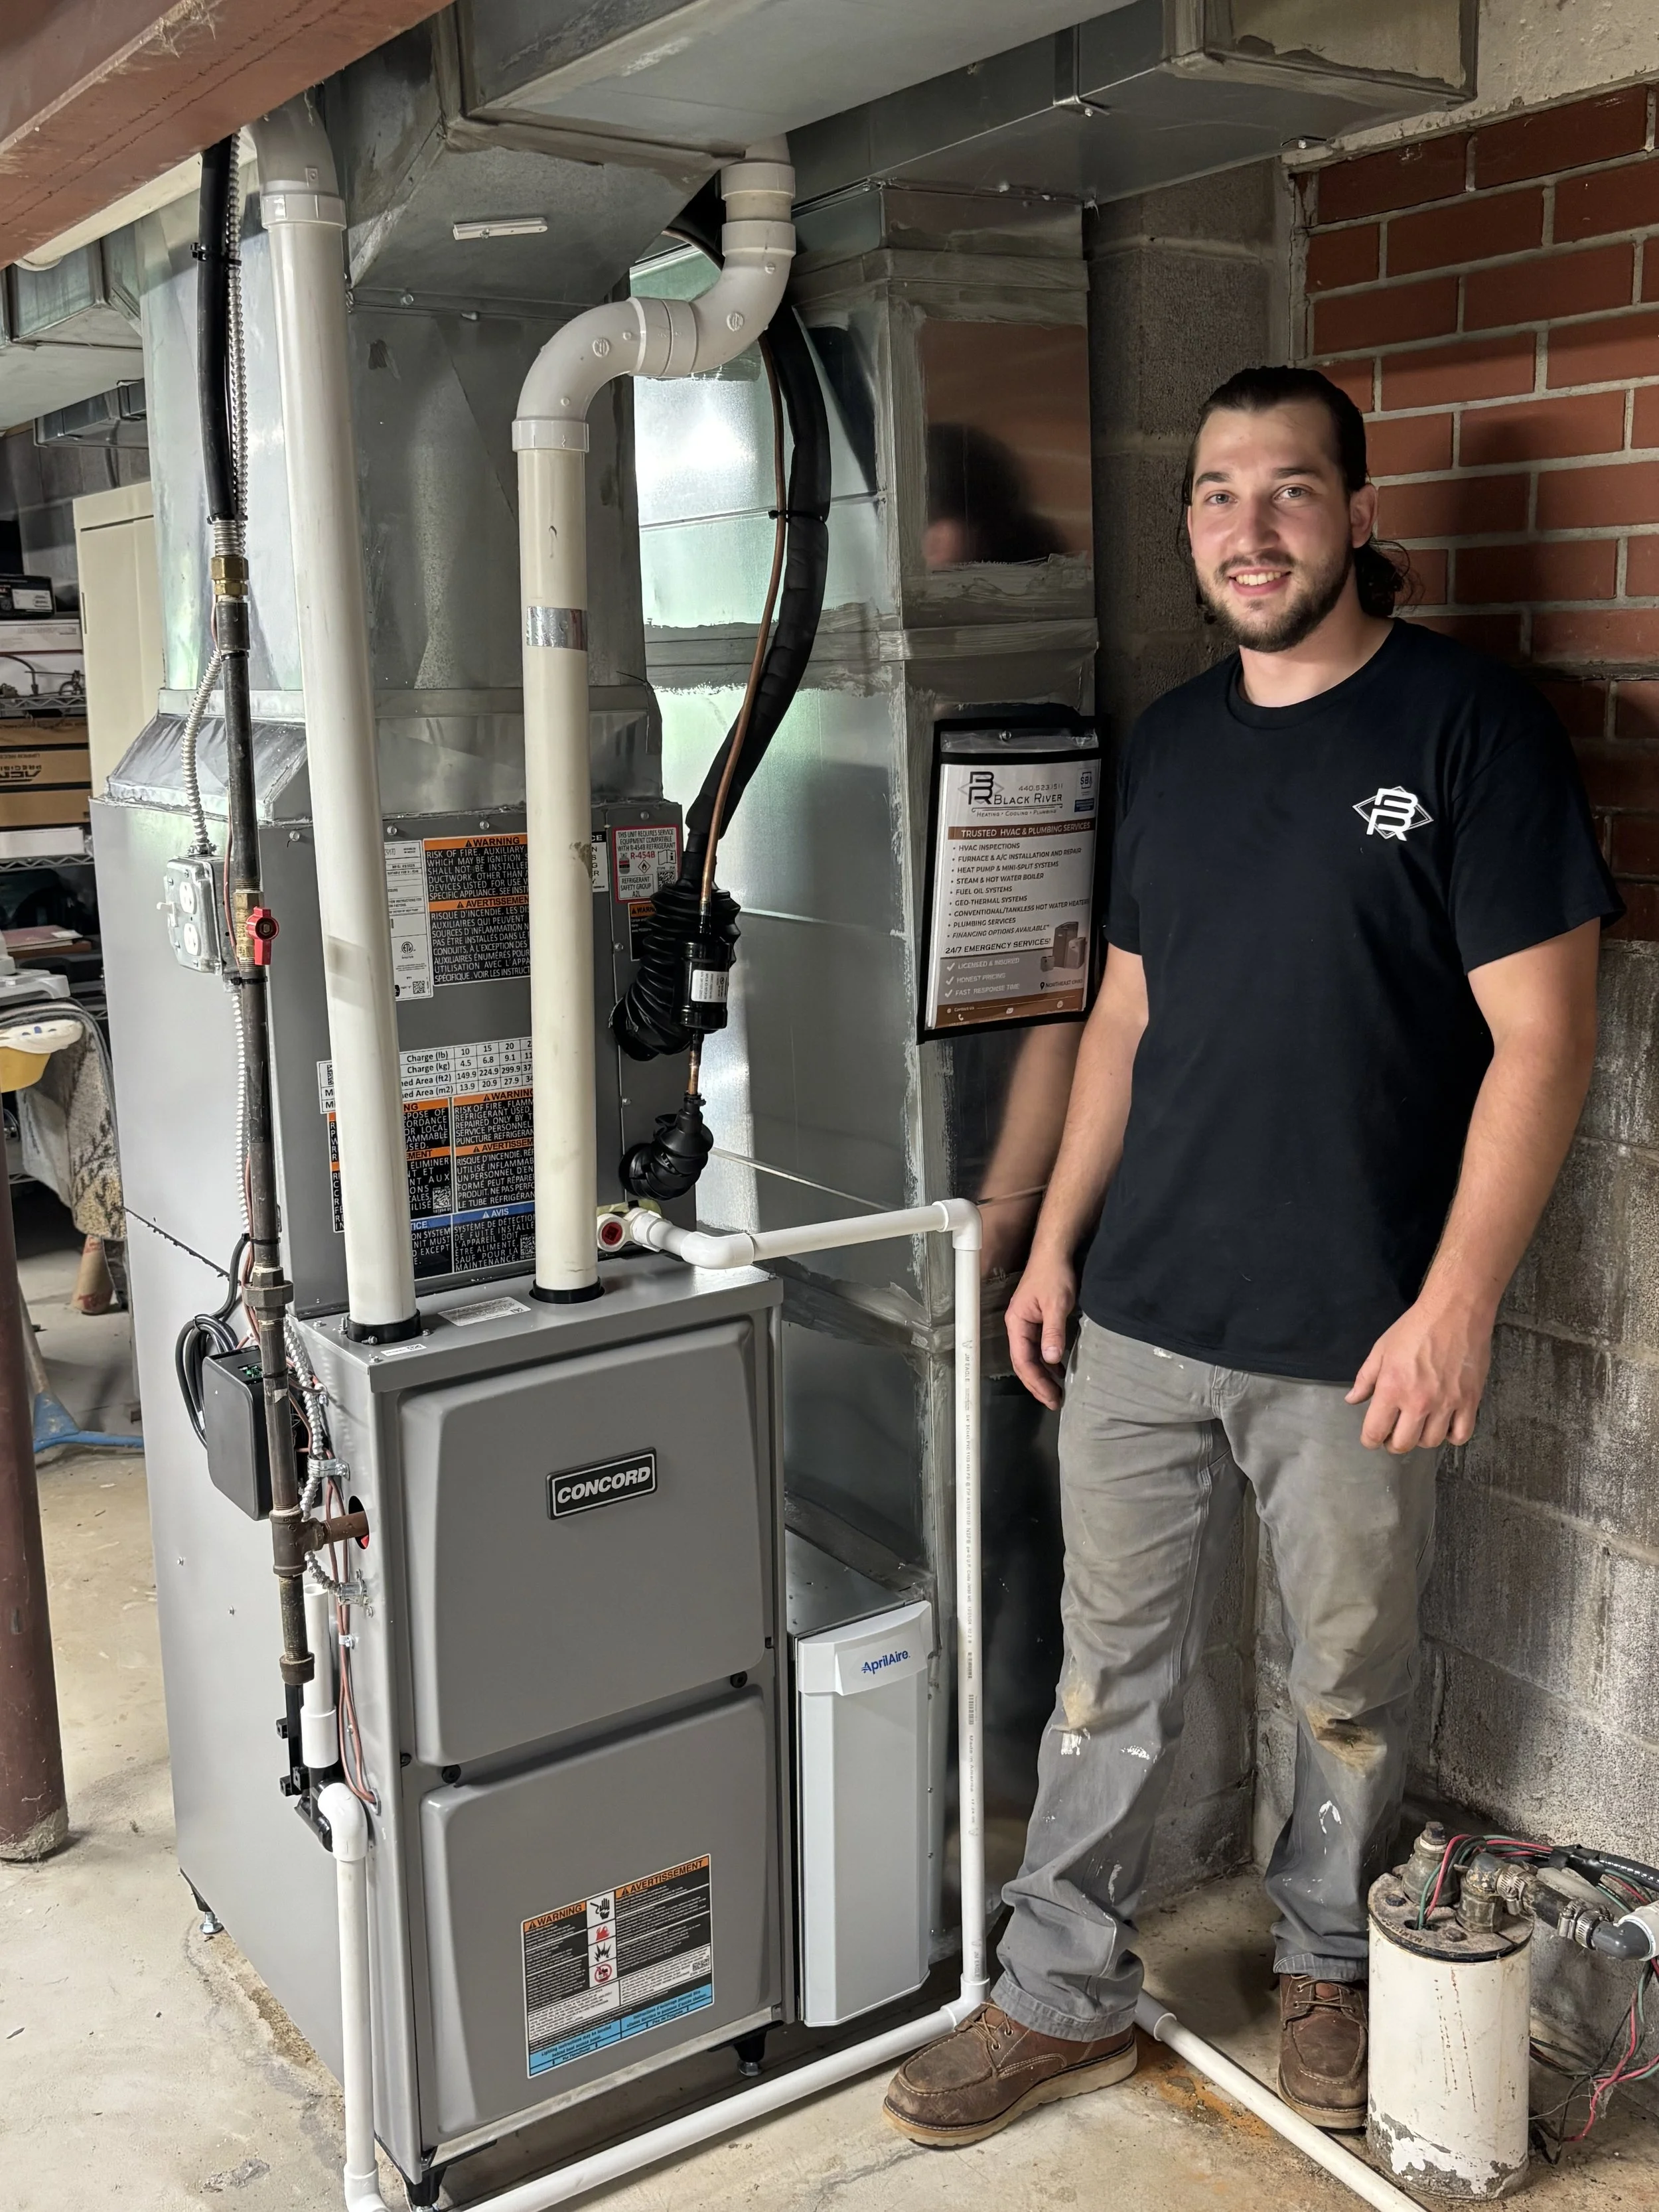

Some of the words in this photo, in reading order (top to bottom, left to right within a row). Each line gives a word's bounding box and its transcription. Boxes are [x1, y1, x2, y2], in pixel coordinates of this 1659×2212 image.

[962, 829, 997, 838] TRUSTED
[1029, 825, 1062, 834] PLUMBING
[473, 837, 520, 846] WARNING
[484, 846, 524, 855] AUXILIARY
[427, 867, 452, 875] SHALL
[429, 883, 461, 891] DEVICES
[466, 897, 528, 908] AVERTISSEMEN
[432, 911, 458, 920] RISQUE
[964, 942, 1011, 952] EMERGENCY
[435, 963, 480, 974] UTILISATION
[407, 1054, 433, 1063] Charge
[407, 1065, 433, 1074] Charge
[436, 1062, 450, 1071] (kg)
[436, 1074, 451, 1084] (ft2)
[457, 1071, 476, 1080] 149.9
[436, 1086, 453, 1096] (m2)
[455, 1108, 508, 1122] REFRIGERANT
[455, 1119, 489, 1129] REPAIRED
[493, 1116, 510, 1124] ONLY
[421, 1124, 447, 1134] LOCAL
[456, 1127, 485, 1137] SERVICE
[457, 1134, 491, 1145] PUNCTURE
[429, 1173, 449, 1183] AUX
[470, 1168, 514, 1181] PERSONNEL
[469, 1198, 487, 1207] TUBE
[491, 1209, 509, 1217] AVIS
[424, 1228, 450, 1238] SYSTEM
[470, 1228, 494, 1238] FUITE
[502, 1232, 518, 1240] DOIT
[430, 1236, 450, 1246] MUST
[421, 1244, 450, 1255] EXCEPT
[455, 1254, 475, 1264] SAUF
[482, 1250, 505, 1259] POUR
[557, 1467, 650, 1504] CONCORD
[861, 1649, 909, 1674] AprilAire
[630, 1860, 703, 1891] AVERTISSEMENT
[538, 1905, 582, 1926] WARNING
